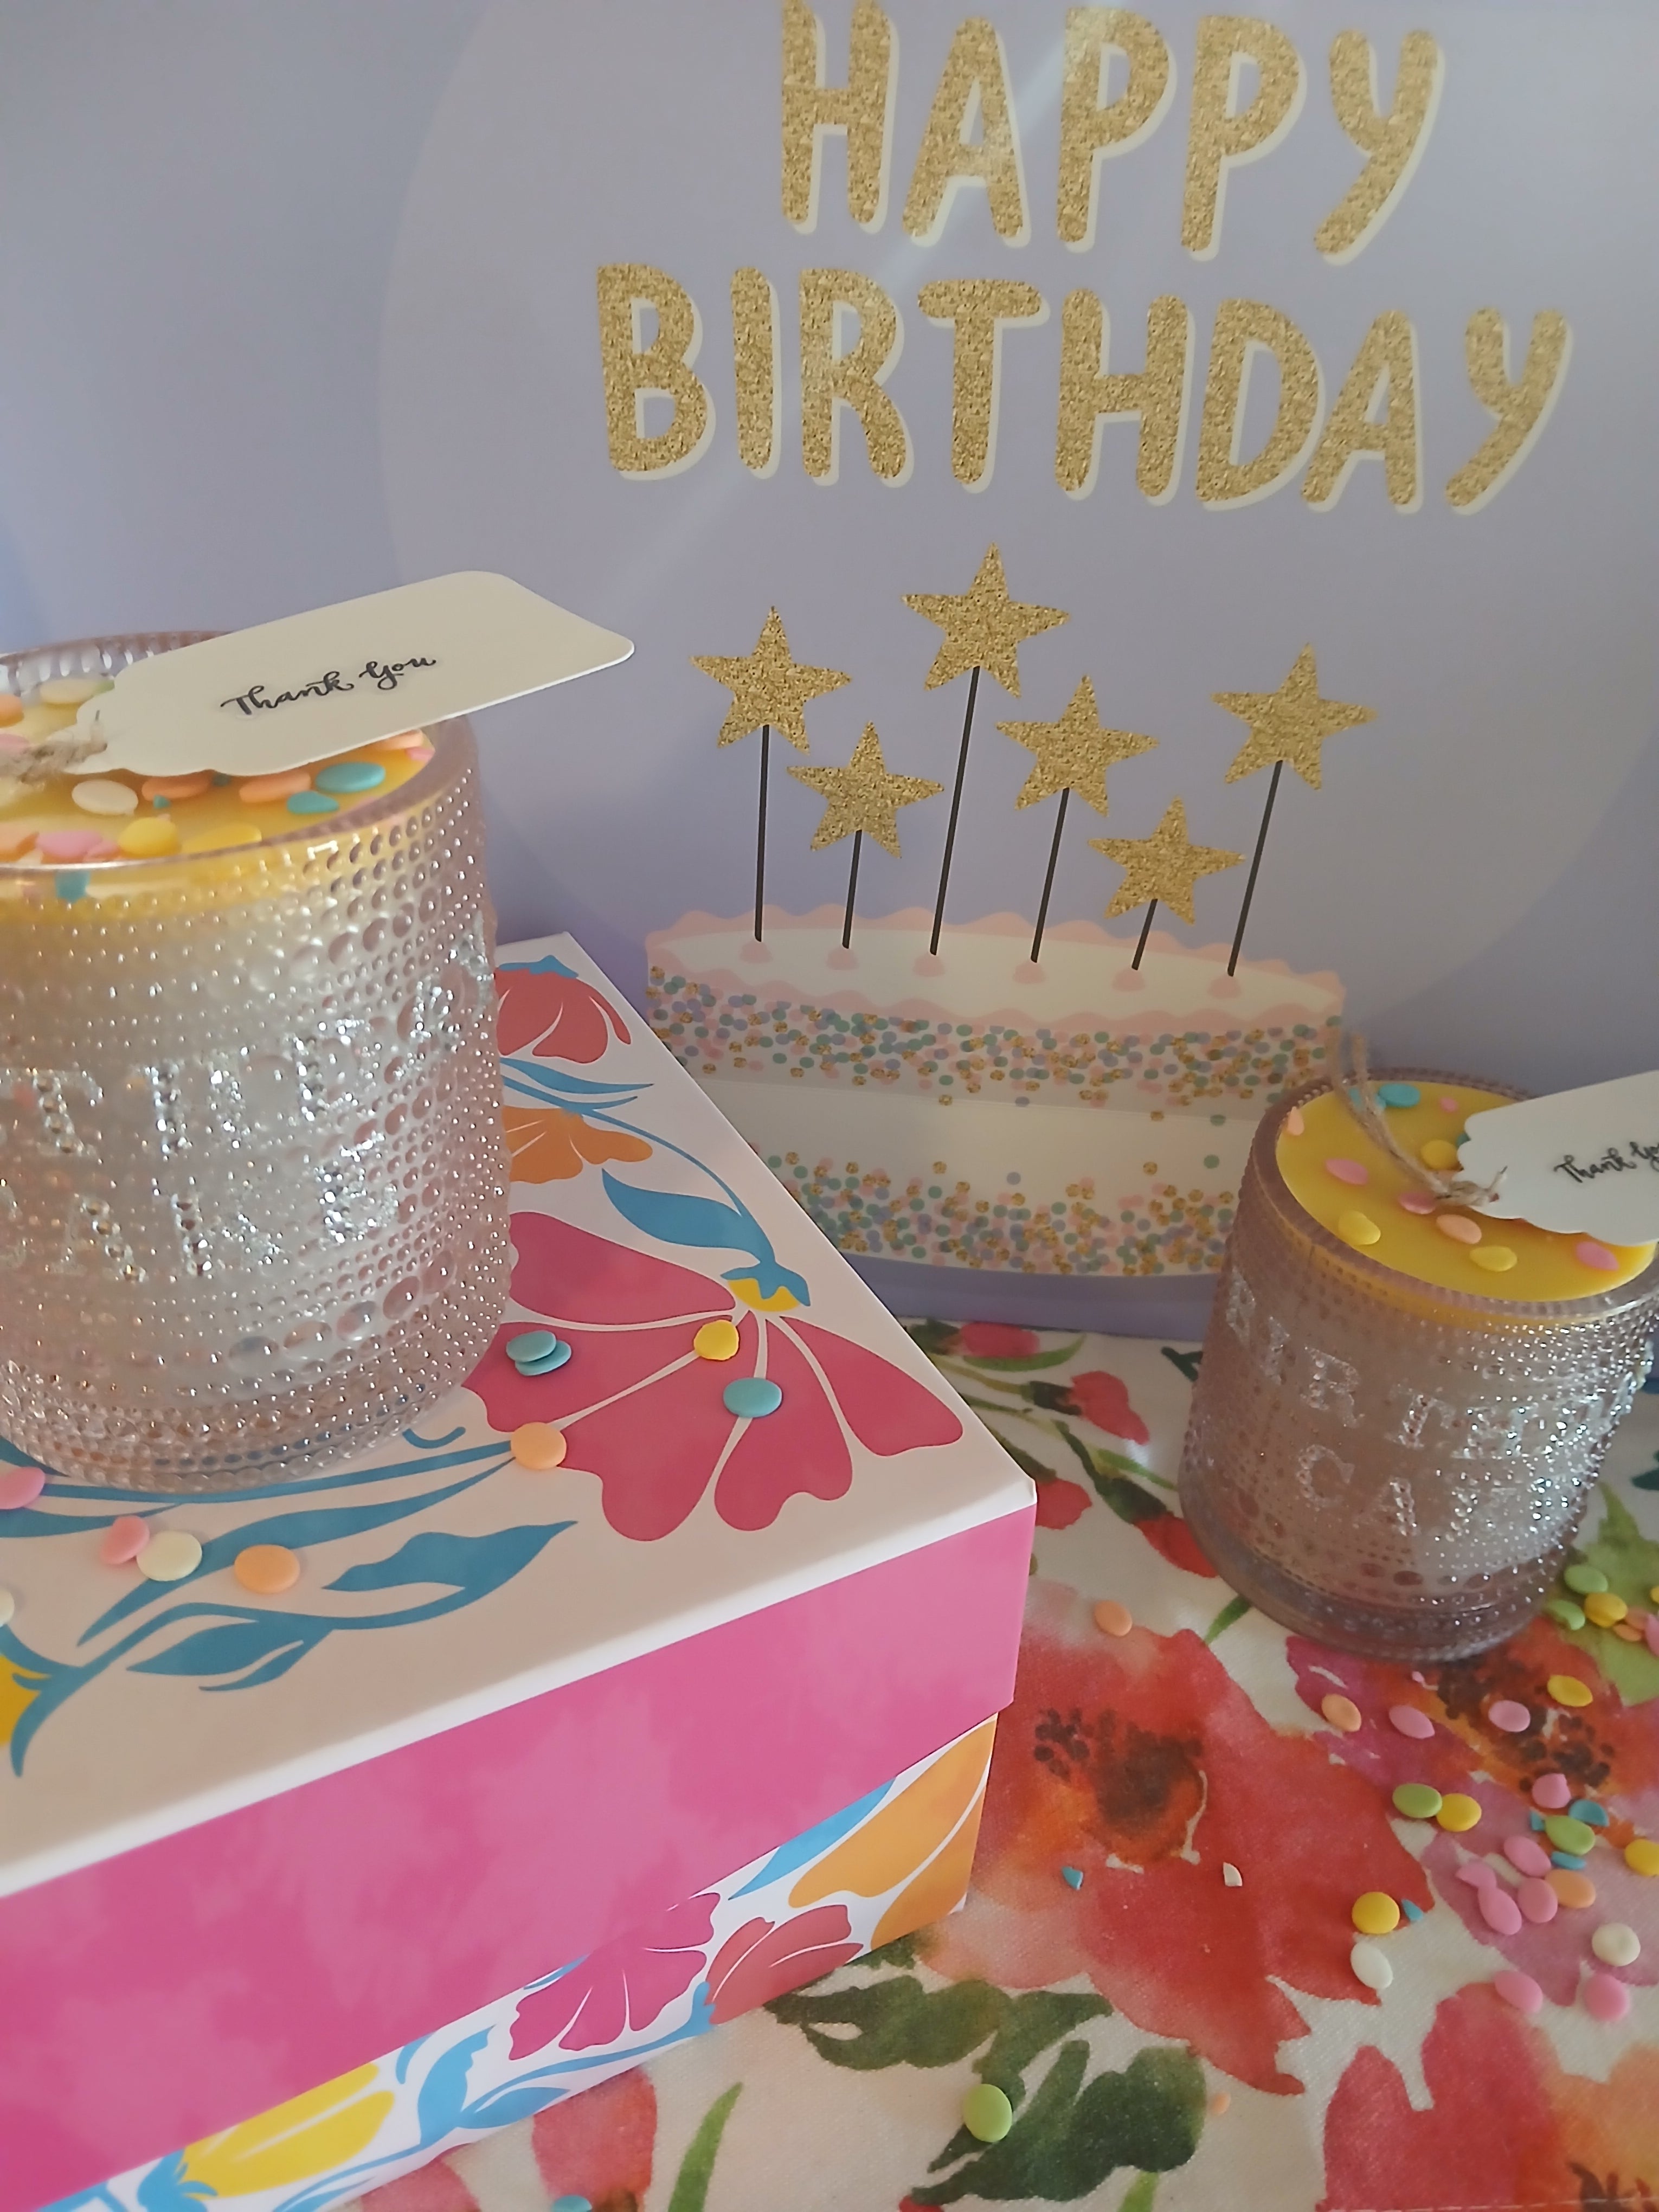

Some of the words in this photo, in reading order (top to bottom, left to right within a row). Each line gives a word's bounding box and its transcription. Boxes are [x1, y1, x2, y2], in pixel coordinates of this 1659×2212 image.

[781, 0, 1444, 264] HAPPY
[597, 263, 1572, 513] BIRTHDAY
[221, 671, 354, 715] Thank
[359, 657, 436, 691] You
[1553, 1147, 1637, 1183] Thank
[1629, 1141, 1659, 1173] Yo
